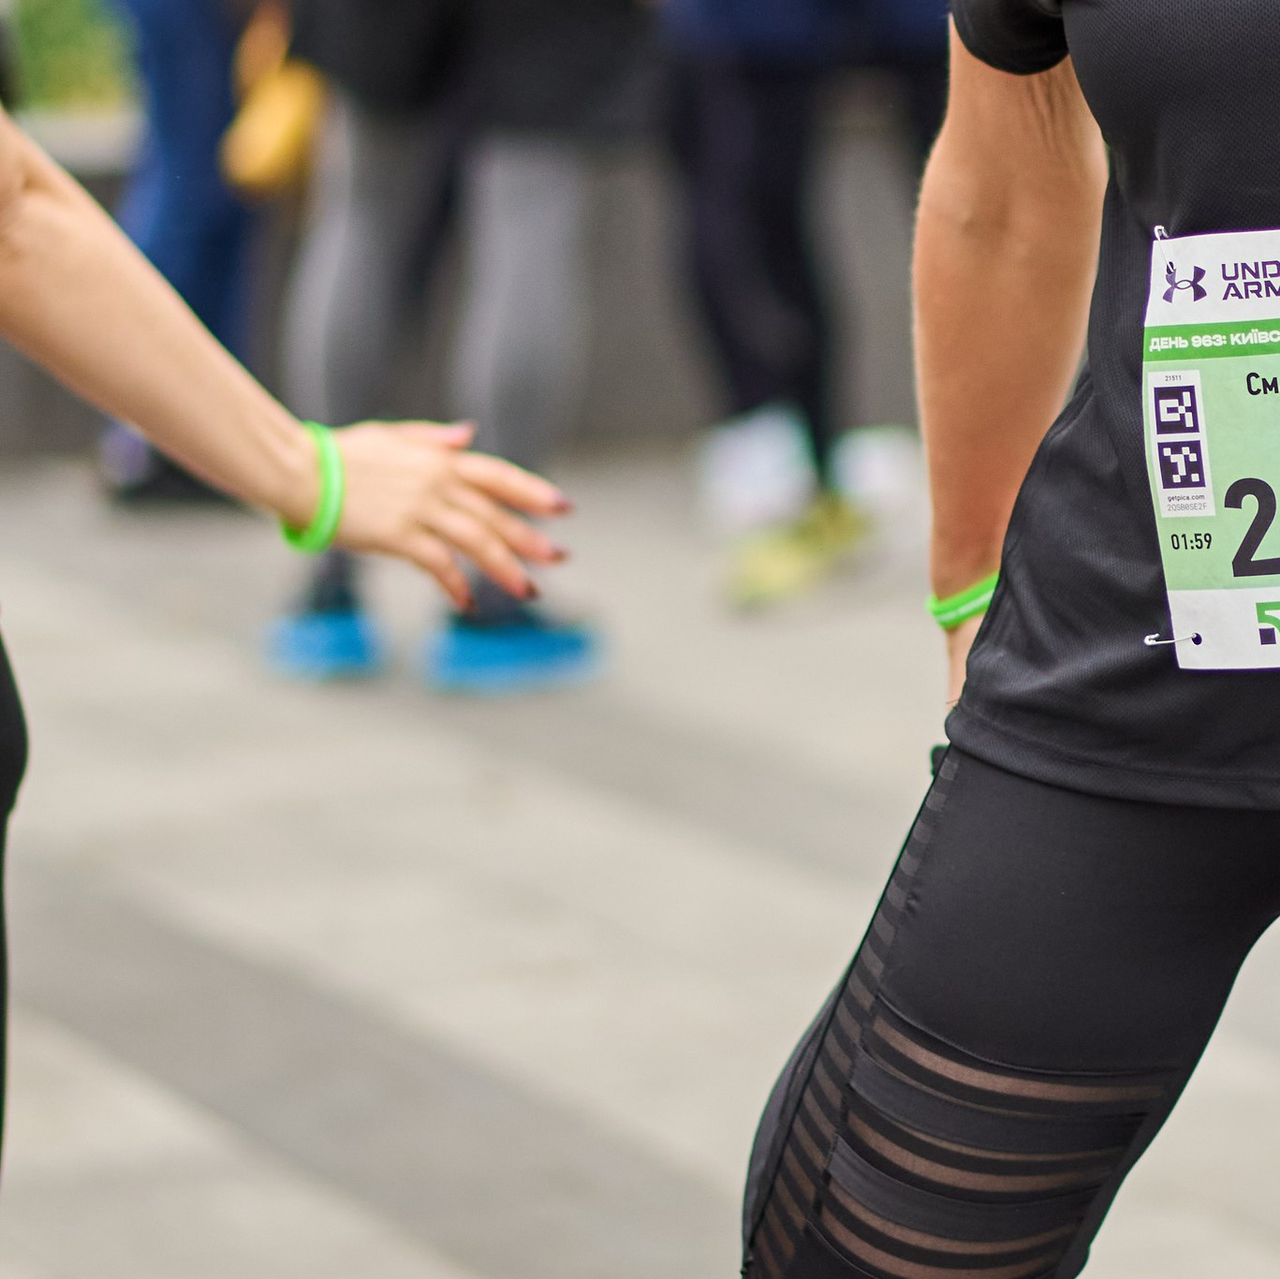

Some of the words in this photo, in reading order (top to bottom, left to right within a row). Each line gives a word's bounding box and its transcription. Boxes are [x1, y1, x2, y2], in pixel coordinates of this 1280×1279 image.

[1149, 336, 1188, 352] ДЕНЬ
[1191, 334, 1226, 349] 963:
[1168, 494, 1205, 502] getpica.com
[1171, 533, 1212, 550] 01:59
